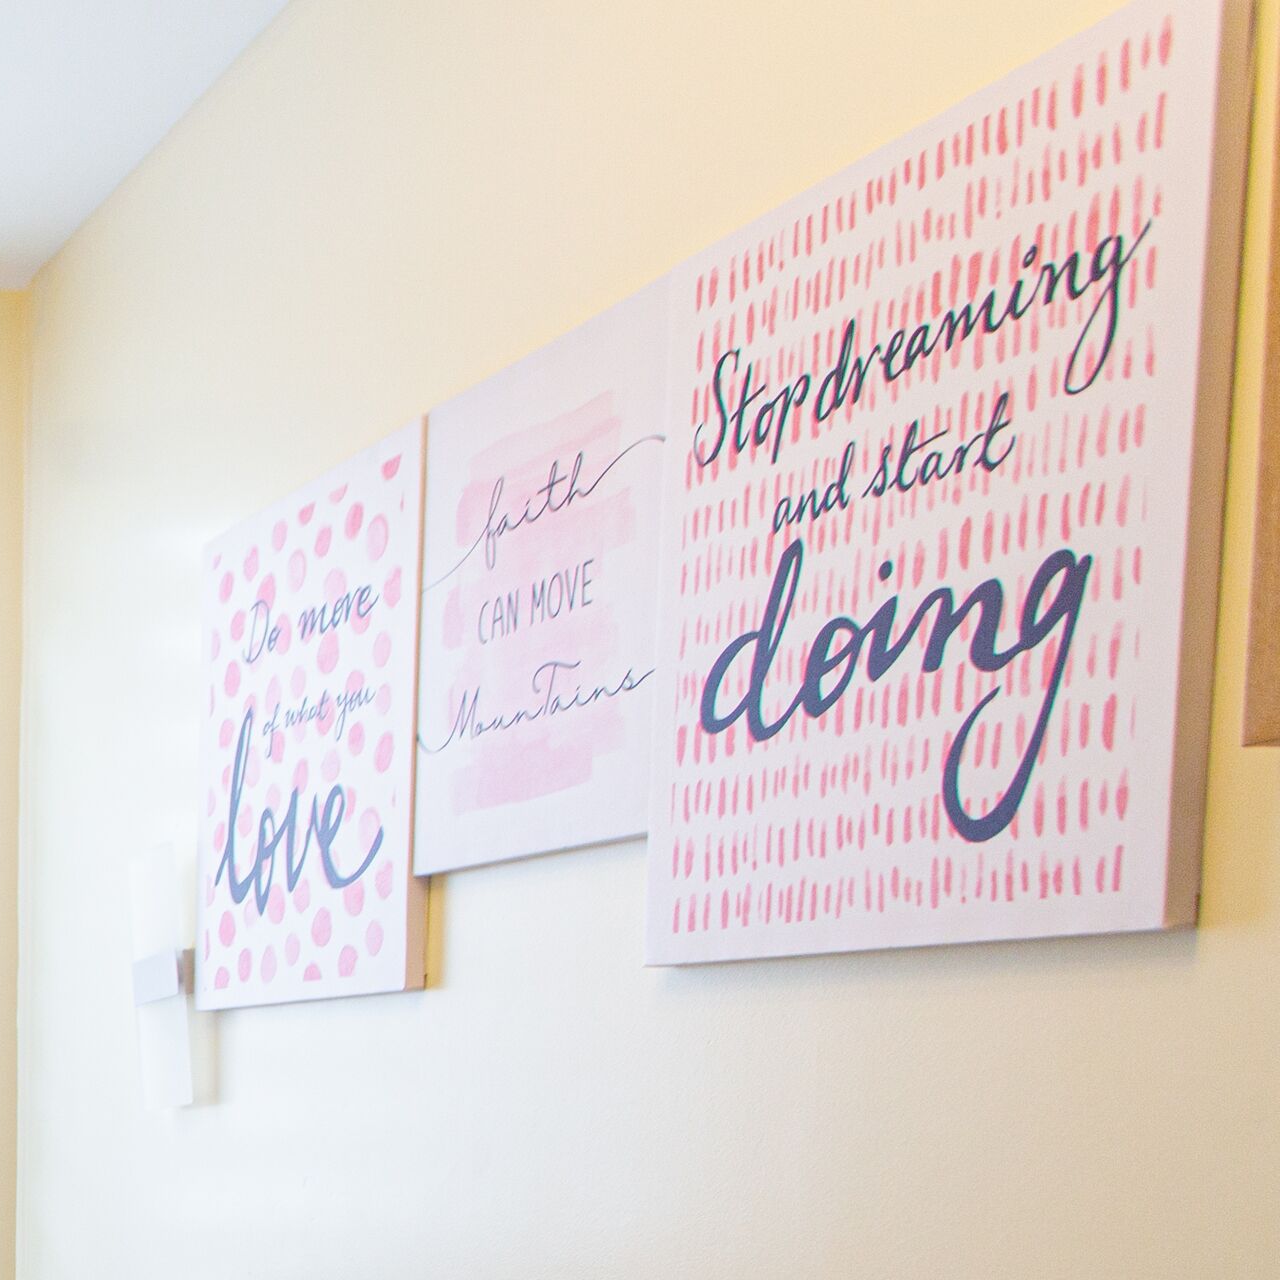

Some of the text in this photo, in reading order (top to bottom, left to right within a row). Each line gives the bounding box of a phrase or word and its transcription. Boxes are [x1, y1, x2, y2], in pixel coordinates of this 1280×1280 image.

[774, 392, 1016, 534] and start
[243, 584, 381, 665] Do more
[478, 558, 595, 645] CAN MOVE
[262, 686, 377, 758] of what you
[700, 538, 1093, 843] doing
[215, 705, 385, 916] love
